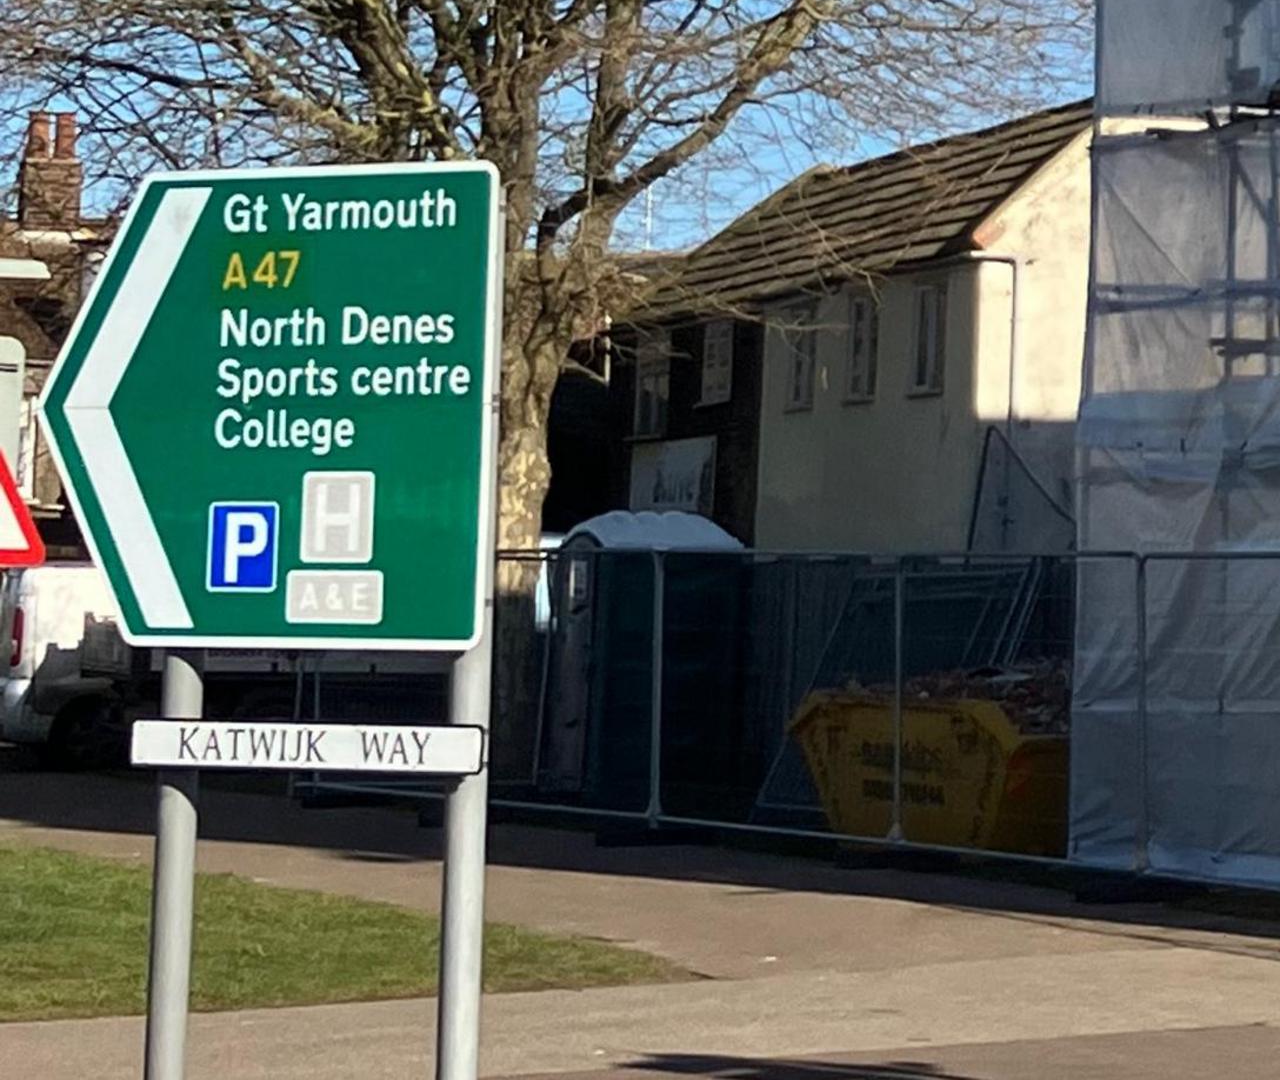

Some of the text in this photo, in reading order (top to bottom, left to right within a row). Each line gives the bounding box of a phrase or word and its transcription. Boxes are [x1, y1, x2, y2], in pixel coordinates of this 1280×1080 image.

[223, 189, 456, 233] Gt Yarmouth
[223, 251, 300, 289] A47
[220, 307, 454, 347] North Denes
[217, 358, 471, 402] Sports centre
[214, 409, 355, 456] College
[313, 483, 361, 552] H
[224, 512, 268, 583] P
[178, 727, 432, 765] KATWIJK WAY
